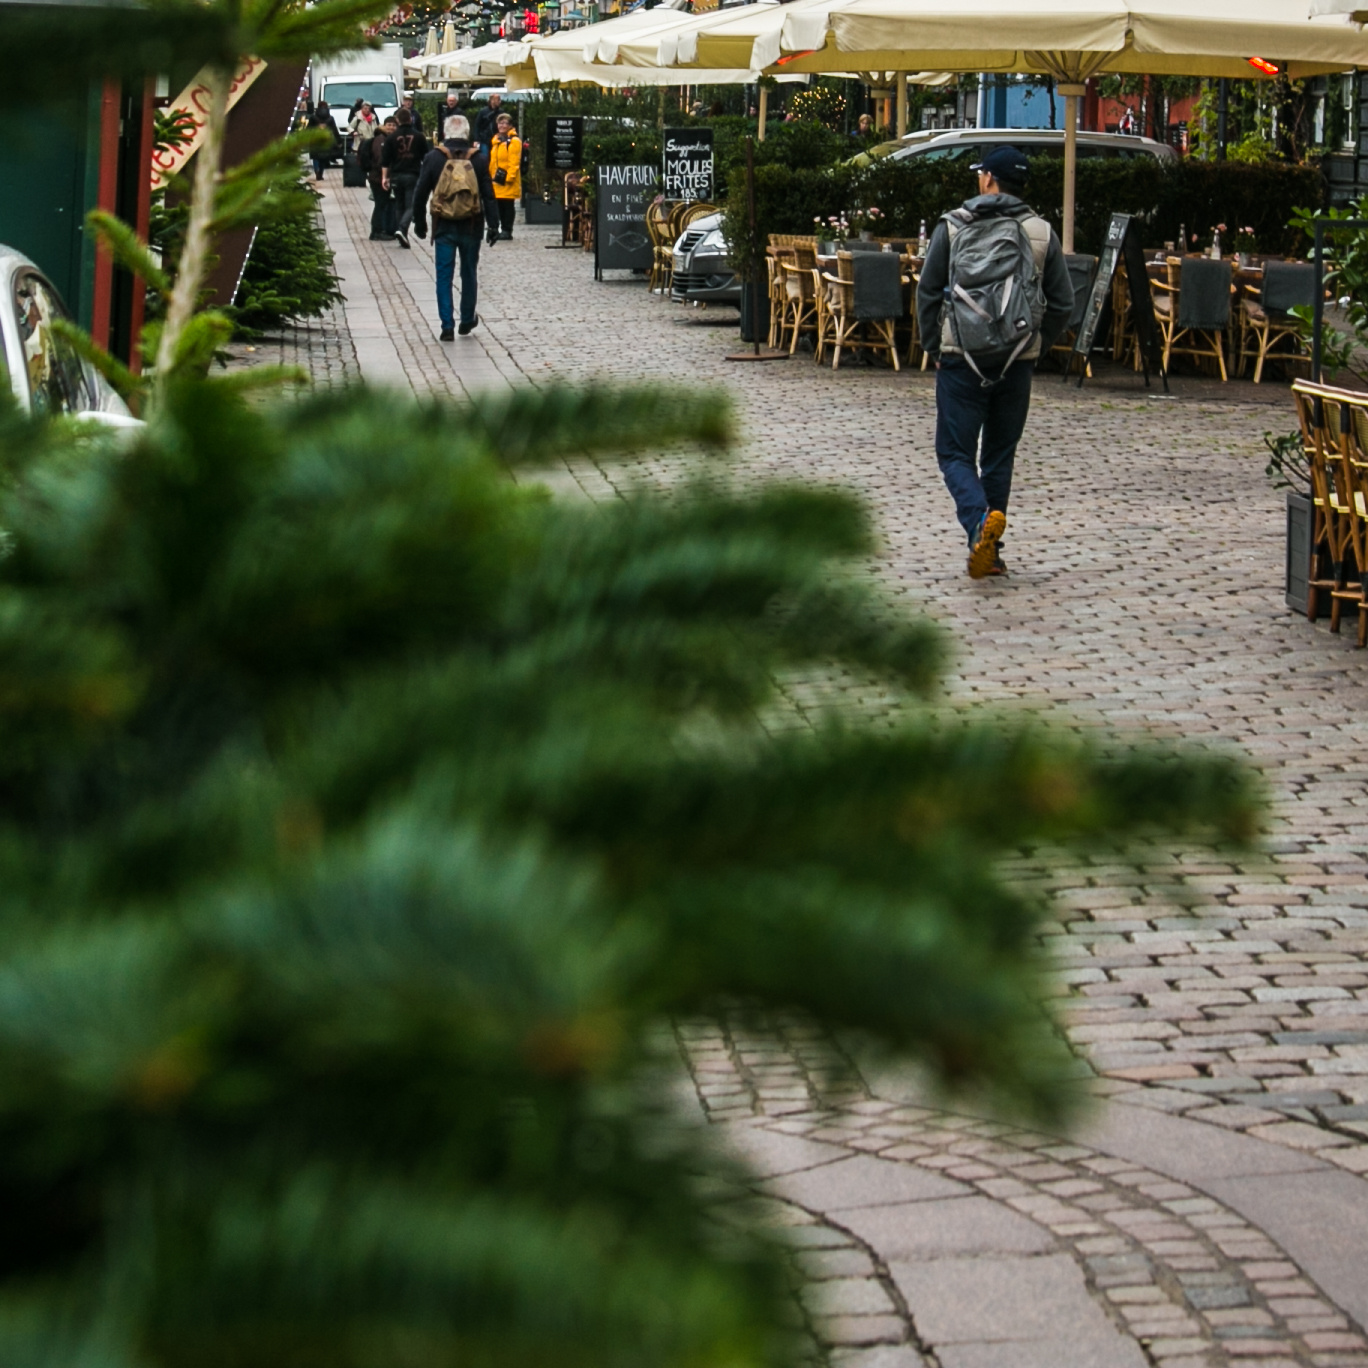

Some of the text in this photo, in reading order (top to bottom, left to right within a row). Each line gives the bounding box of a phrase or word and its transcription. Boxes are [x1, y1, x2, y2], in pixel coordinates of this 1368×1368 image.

[396, 134, 415, 153] 37
[667, 159, 713, 175] MOULES
[598, 165, 659, 186] HAVFRUEN
[666, 174, 709, 190] FRITES
[611, 194, 622, 204] EN
